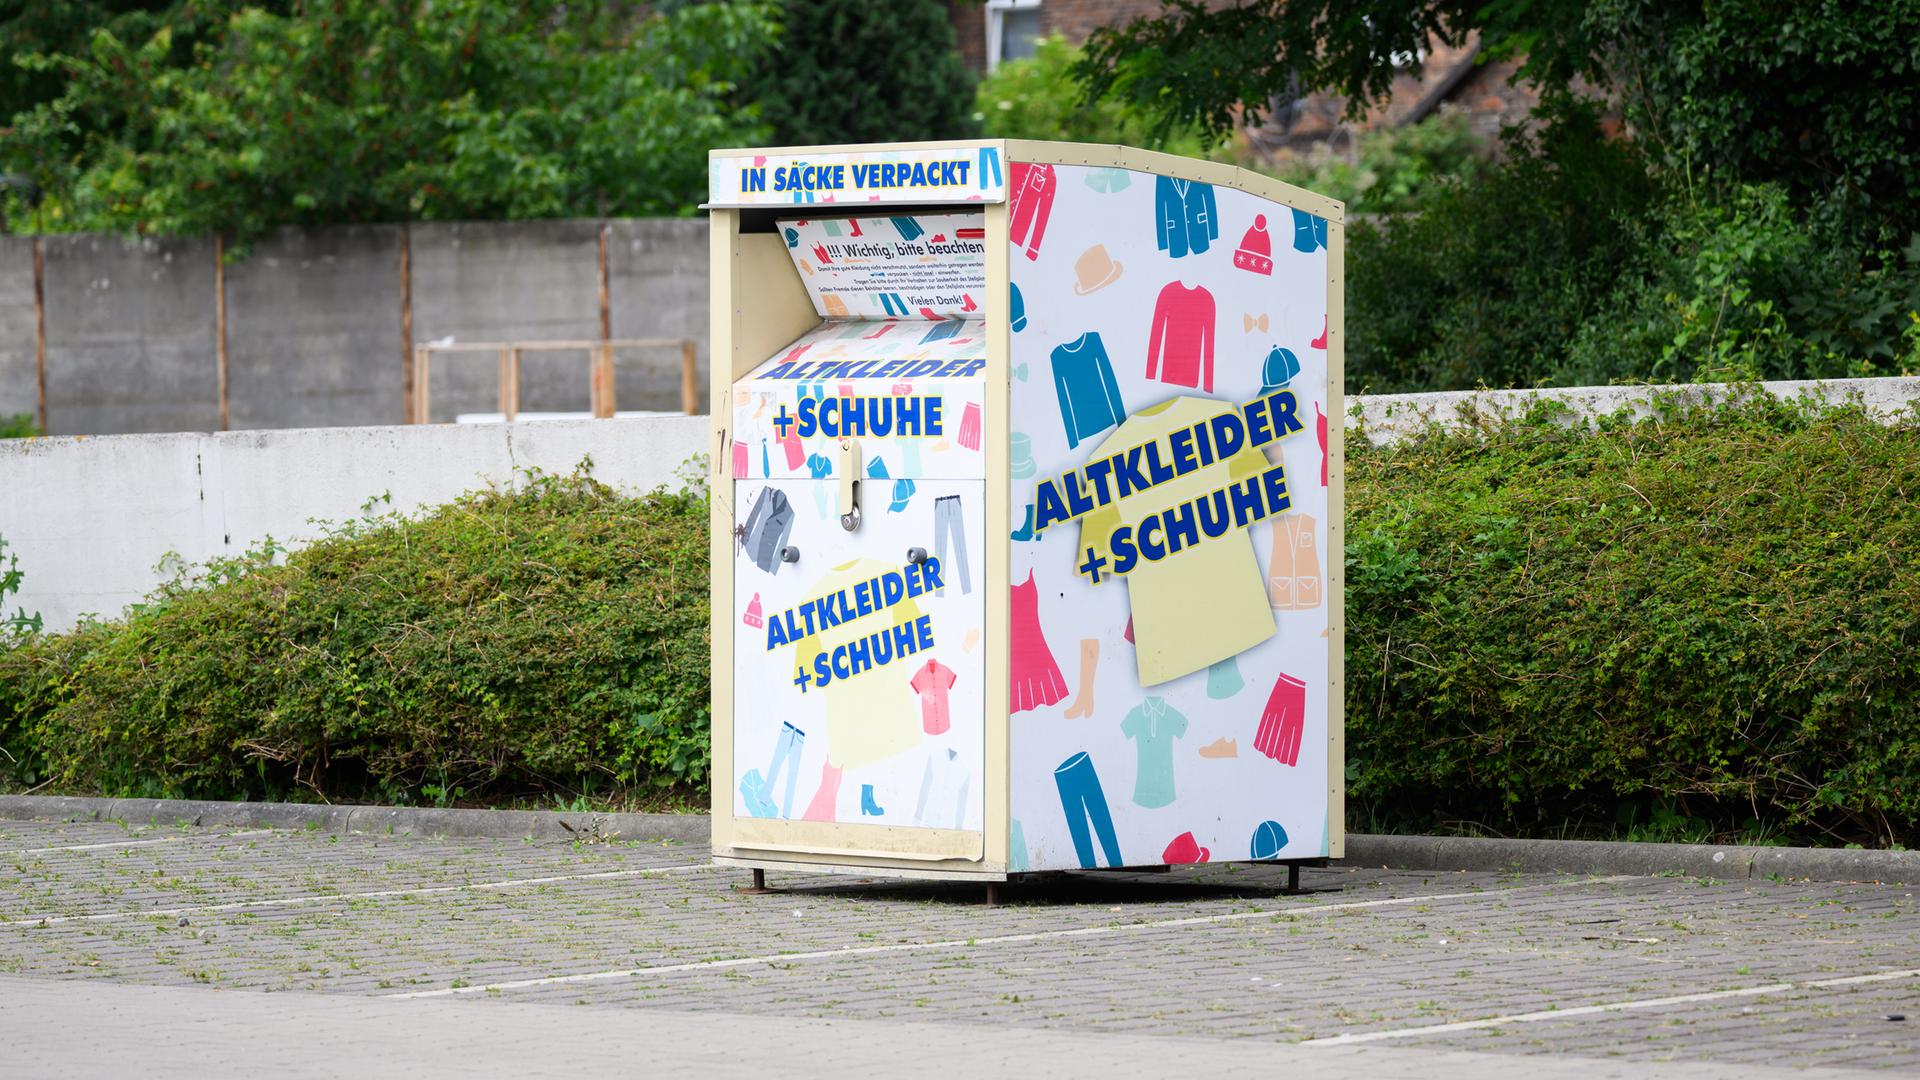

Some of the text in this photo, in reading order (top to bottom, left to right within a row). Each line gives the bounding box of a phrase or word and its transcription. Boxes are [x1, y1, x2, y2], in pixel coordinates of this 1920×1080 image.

[741, 161, 970, 192] IN SÄCKE VERPACKT
[827, 240, 984, 259] !!! Wichtig, bitte beachten
[907, 294, 963, 306] Vielen Dank!
[755, 359, 985, 380] ALTKLEIDER
[774, 396, 944, 438] +SCHUHE
[1034, 390, 1303, 531] ALTKLEIDER
[1080, 466, 1292, 584] +SCHUHE
[767, 556, 945, 651] ALTKLEIDER
[794, 614, 935, 694] +SCHUHE
